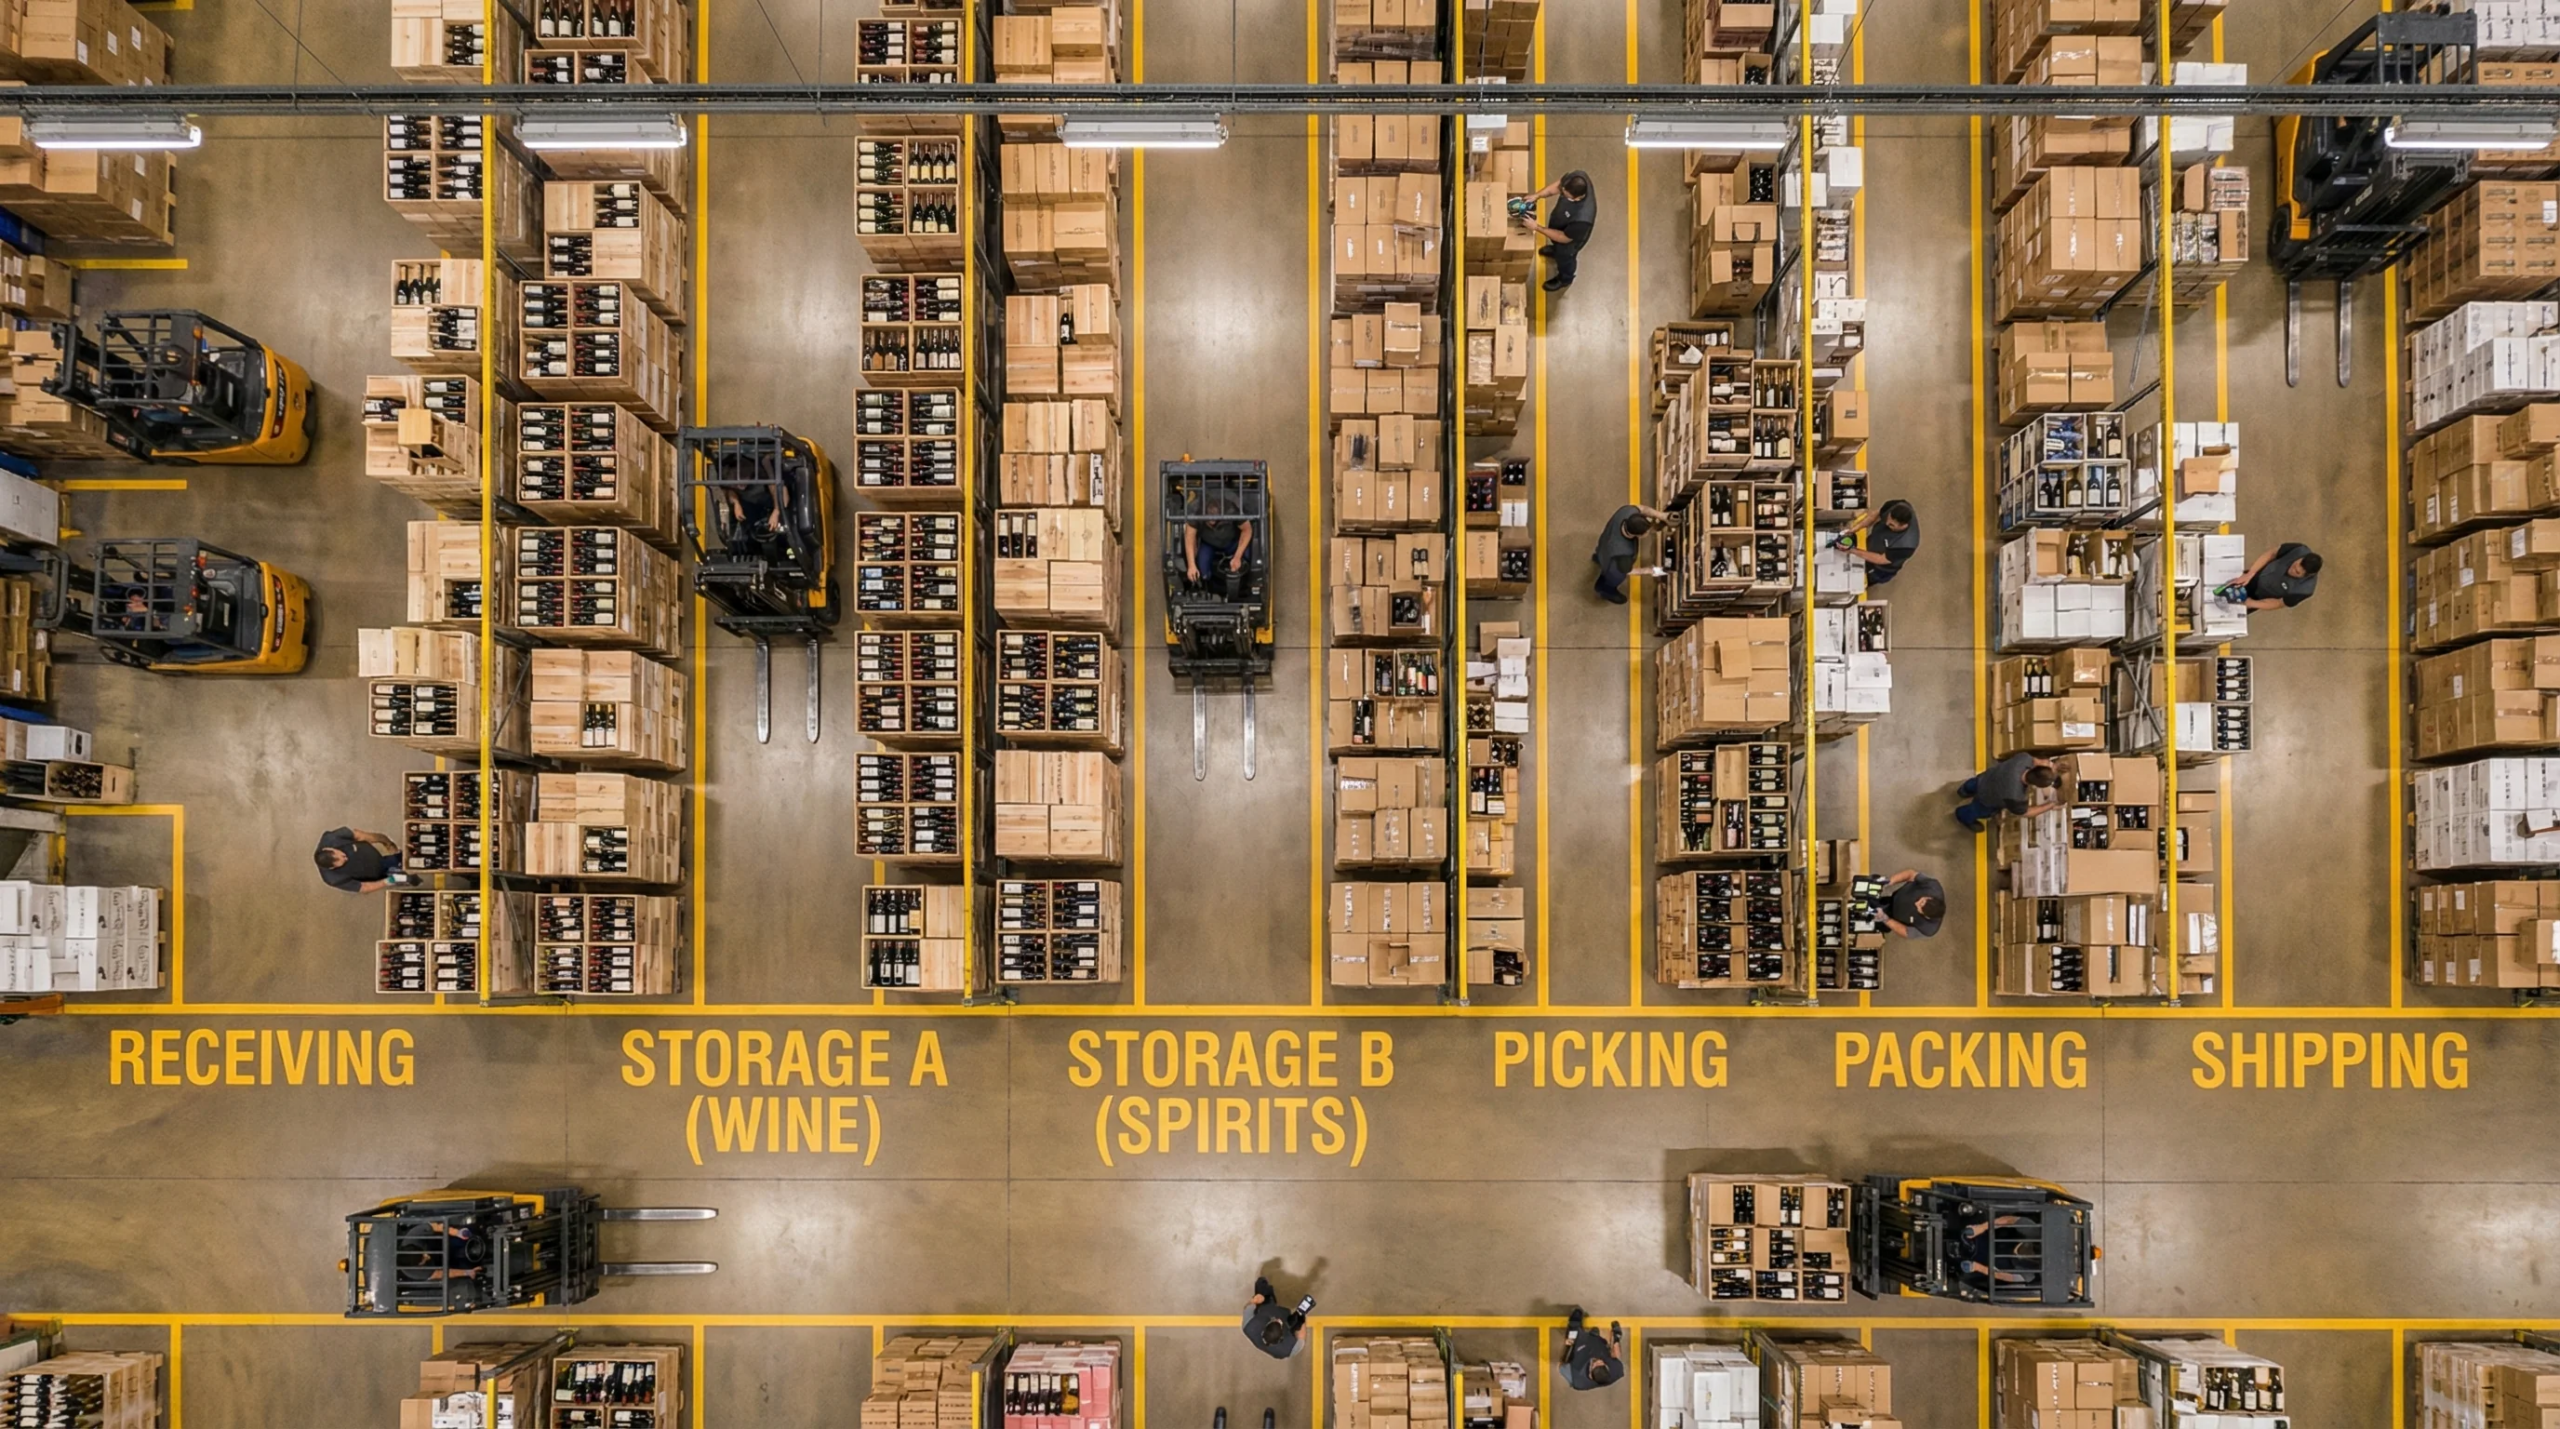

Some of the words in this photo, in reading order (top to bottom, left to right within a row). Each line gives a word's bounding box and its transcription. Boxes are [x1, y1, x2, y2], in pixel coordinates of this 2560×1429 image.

[108, 1028, 415, 1087] RECEIVING
[620, 1028, 892, 1088] STORAGE
[908, 1029, 949, 1088] A
[1067, 1028, 1339, 1089] STORAGE
[1359, 1030, 1395, 1088] B
[1493, 1029, 1728, 1089] PICKING
[1834, 1029, 2089, 1090] PACKING
[2190, 1029, 2469, 1090] SHIPPING
[684, 1095, 881, 1166] (WINE)
[1094, 1096, 1369, 1167] (SPIRITS)
